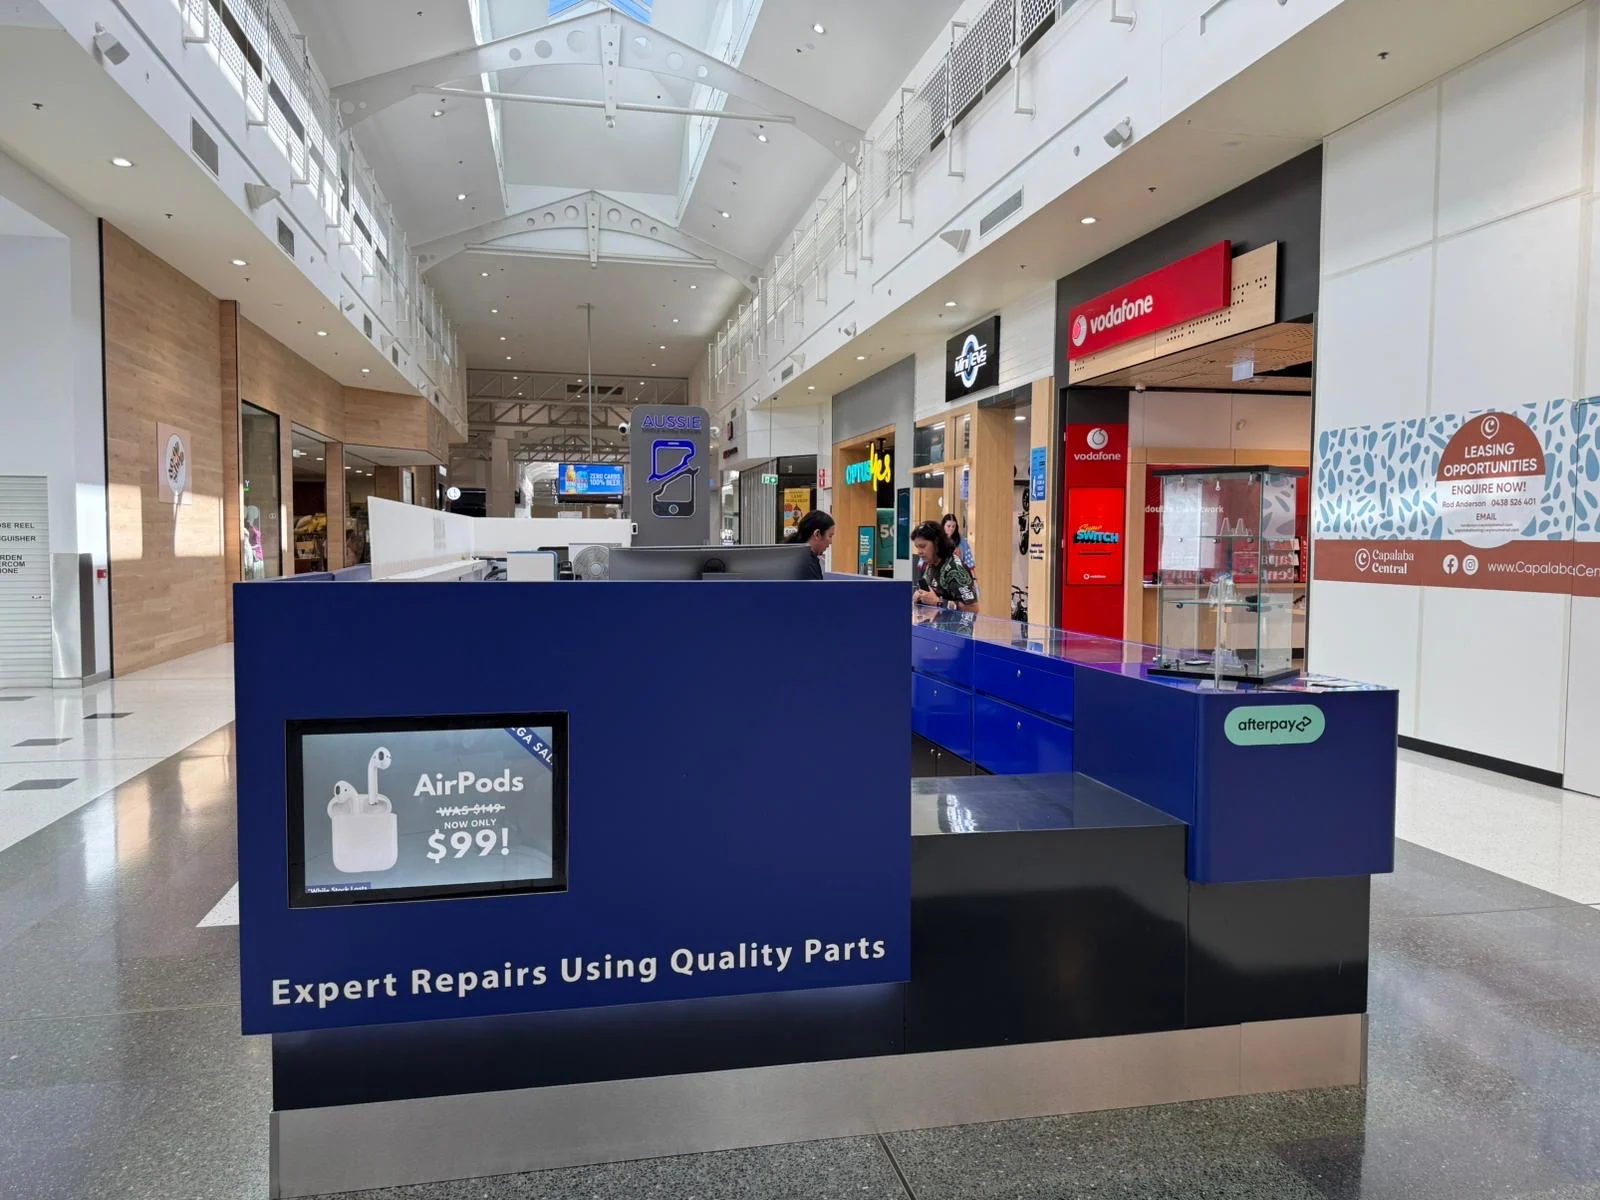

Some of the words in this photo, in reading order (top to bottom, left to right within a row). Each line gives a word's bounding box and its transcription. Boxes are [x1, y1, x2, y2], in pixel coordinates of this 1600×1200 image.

[1090, 294, 1154, 335] vodafone
[641, 415, 702, 430] AUSSIE
[1073, 451, 1121, 461] vodafone
[1464, 442, 1515, 458] LEASING
[846, 459, 872, 485] OPTUS
[1443, 458, 1537, 477] OPPORTUNITIES
[1452, 483, 1493, 495] ENQUIRE
[1496, 481, 1526, 493] NOW!
[1510, 498, 1522, 506] 526
[1075, 529, 1120, 543] SWITCH
[1372, 549, 1415, 562] Capalaba
[1372, 563, 1408, 575] Central
[1238, 718, 1296, 733] afterpay
[511, 727, 533, 745] GA
[533, 742, 553, 766] SAL
[413, 768, 524, 796] AirPods
[440, 805, 469, 816] WAS
[473, 803, 502, 814] $149
[444, 820, 468, 829] NOW
[471, 818, 497, 828] ONLY
[426, 828, 510, 864] $99!
[272, 973, 398, 1009] Expert
[411, 962, 547, 997] Repairs
[560, 954, 657, 983] Using
[670, 942, 793, 975] Quality
[804, 937, 886, 963] Parts
